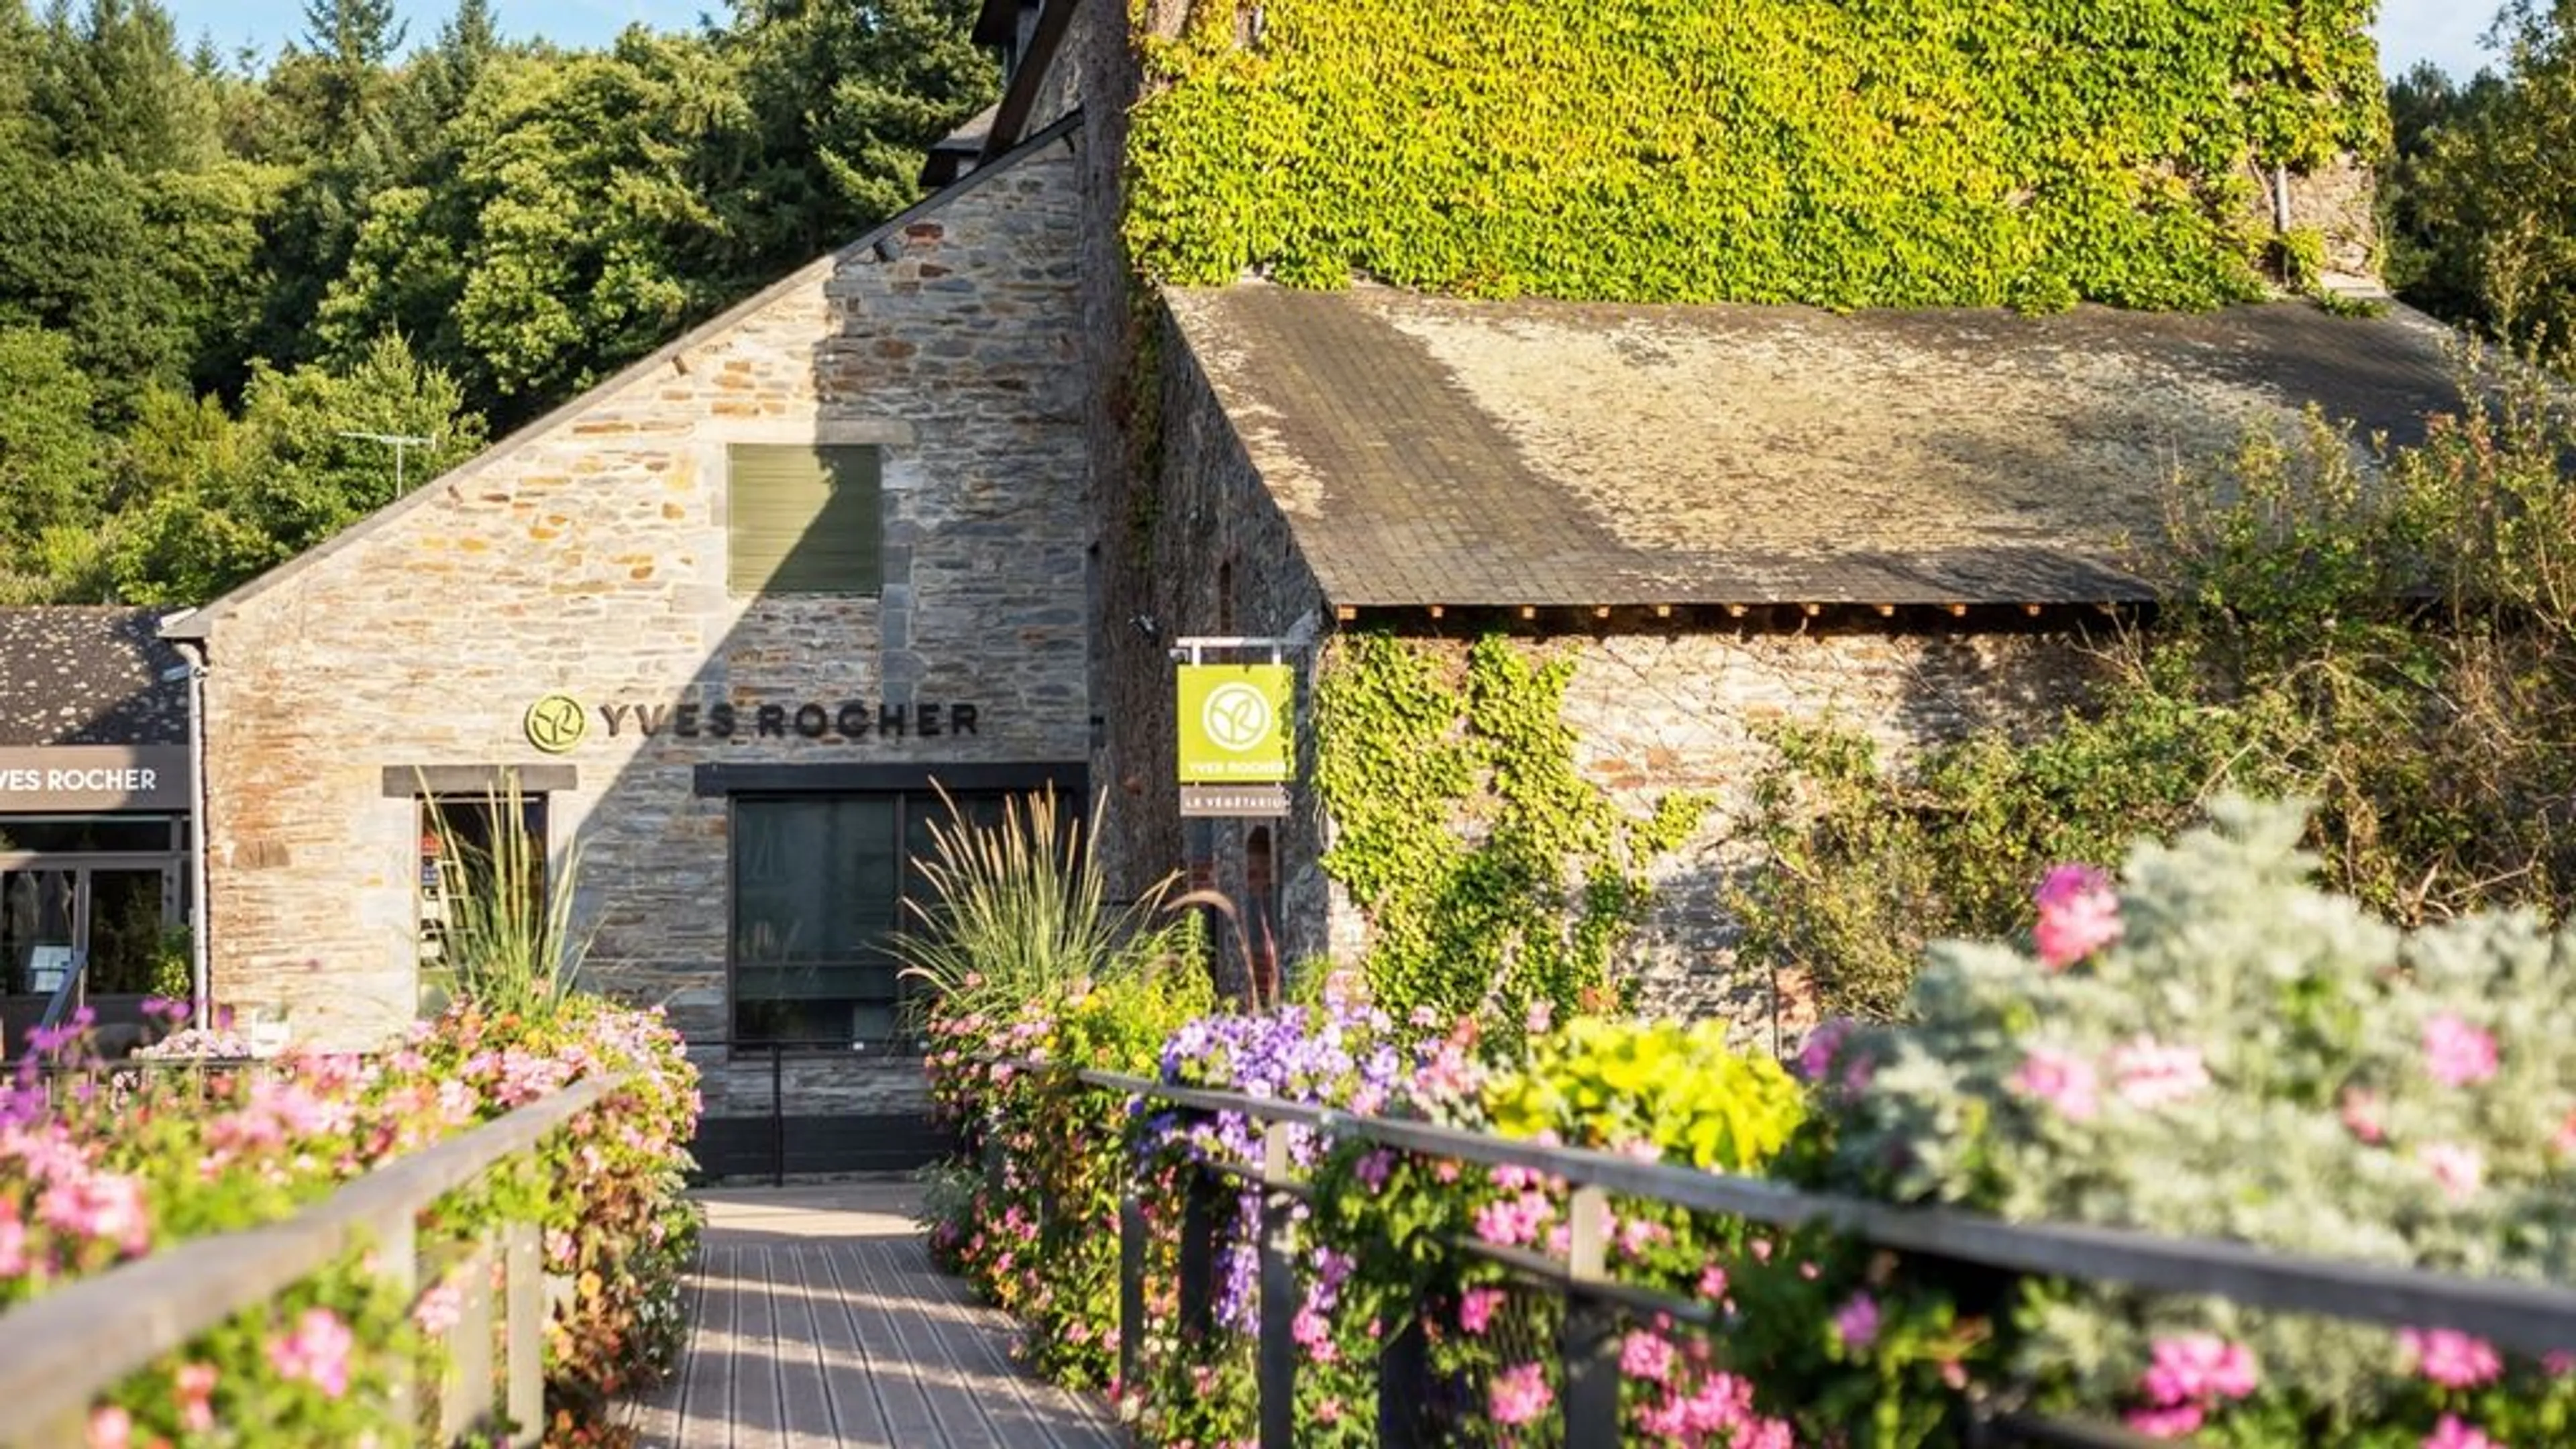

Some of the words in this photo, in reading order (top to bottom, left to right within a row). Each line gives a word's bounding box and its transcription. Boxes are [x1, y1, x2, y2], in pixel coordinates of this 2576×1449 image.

[599, 704, 735, 737] YVES
[758, 701, 977, 738] ROCHER
[47, 769, 156, 791] ROCHER
[1185, 797, 1201, 808] LE
